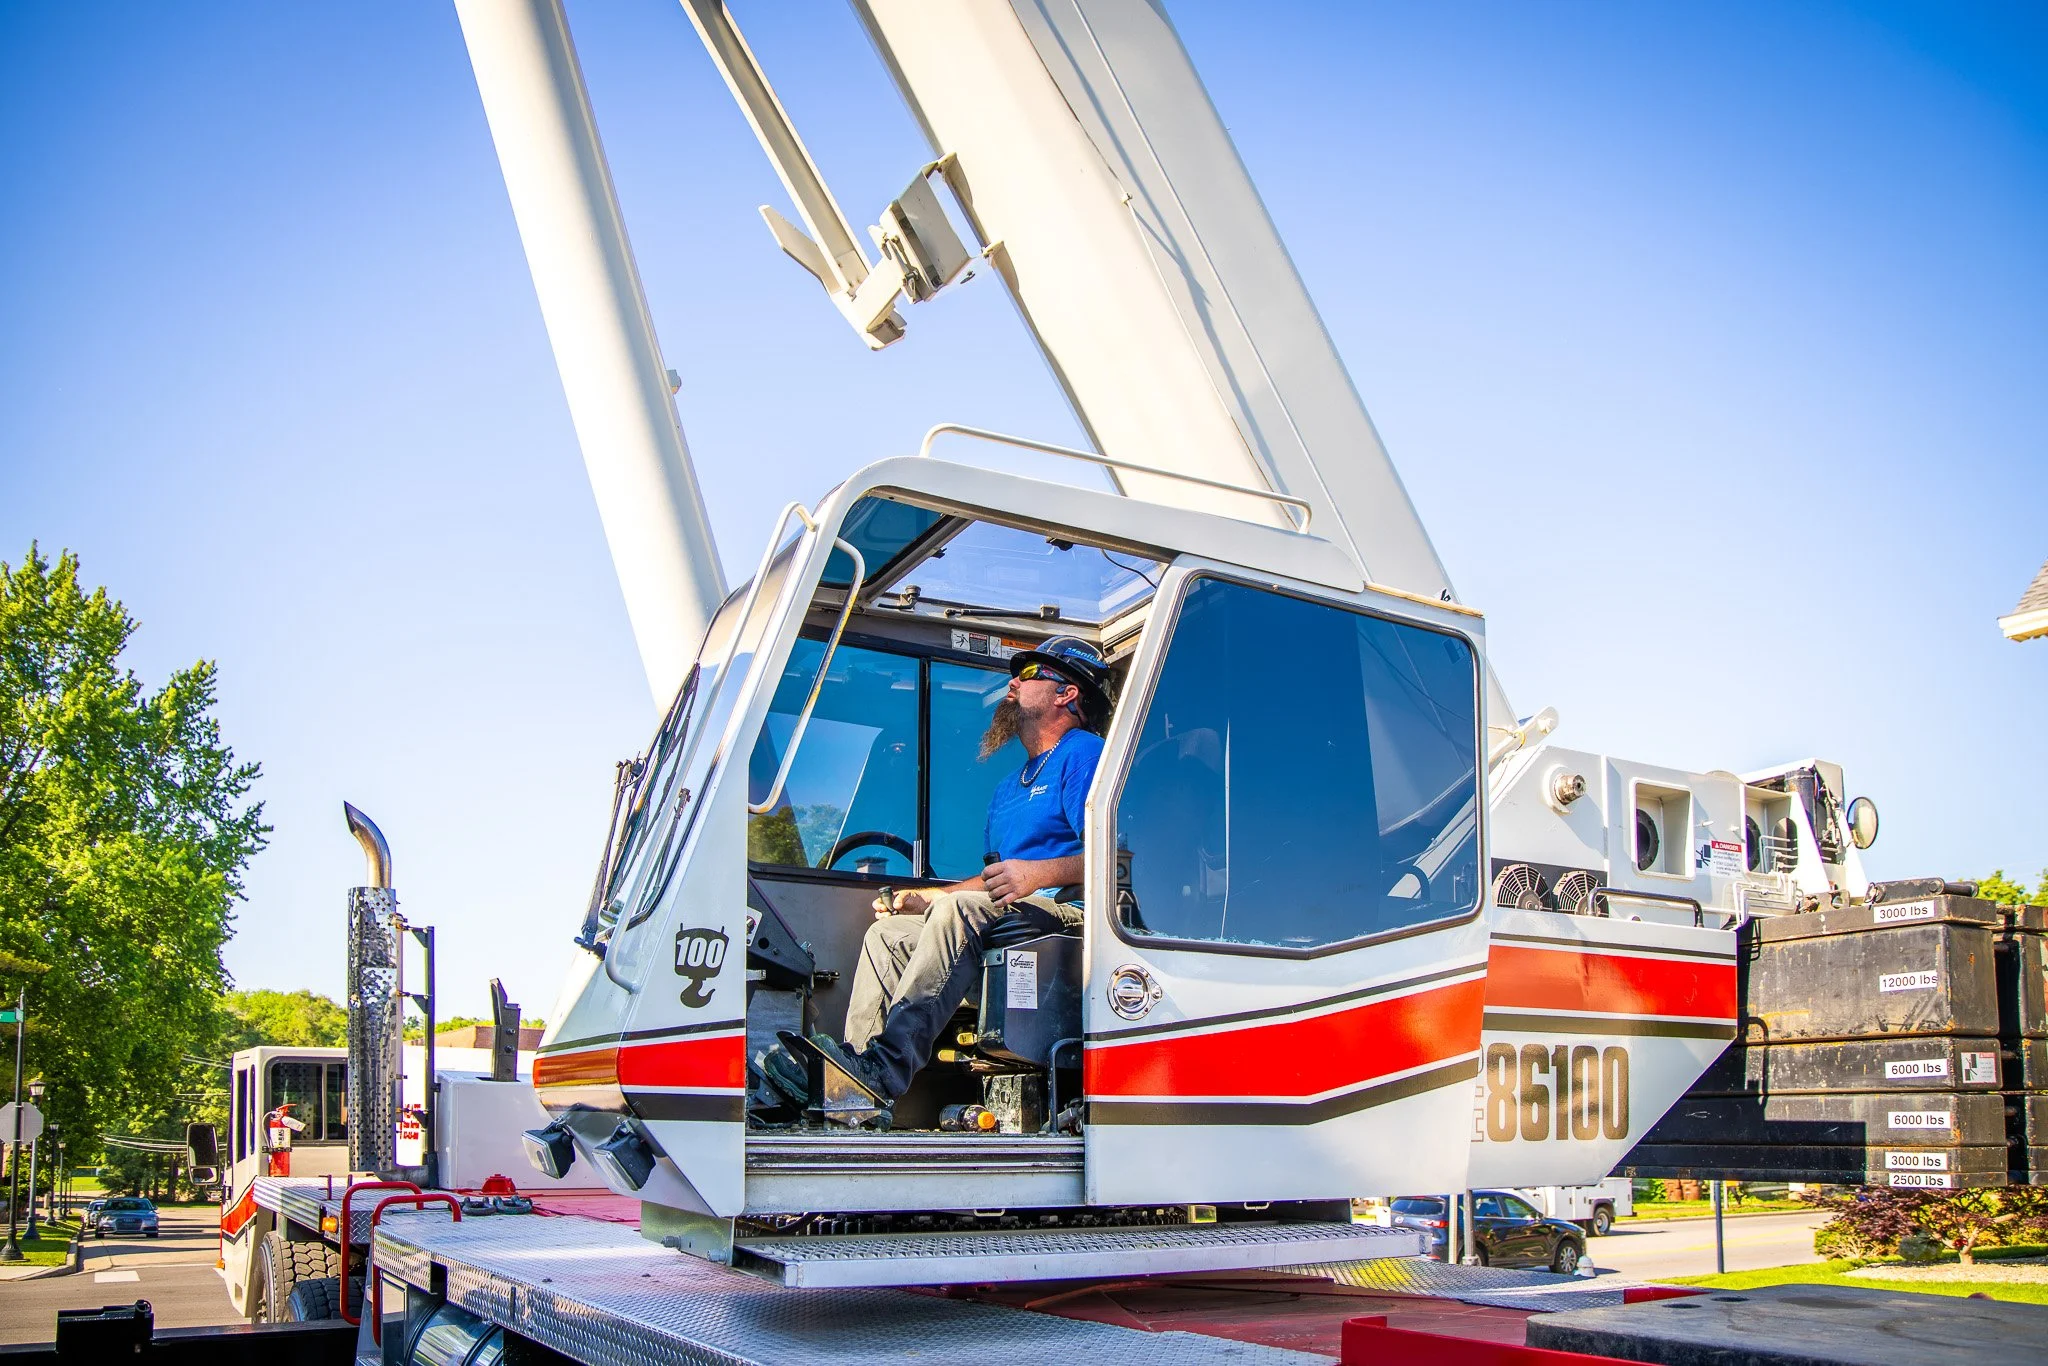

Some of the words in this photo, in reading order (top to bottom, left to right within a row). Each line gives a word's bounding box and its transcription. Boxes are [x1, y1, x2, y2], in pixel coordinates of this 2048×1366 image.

[1879, 907, 1907, 919] 3000
[1910, 906, 1928, 916] lbs
[676, 936, 726, 969] 100
[1882, 975, 1916, 988] 12000
[1919, 974, 1938, 985] lbs
[1891, 1064, 1920, 1075] 6000
[1923, 1063, 1942, 1073] lbs
[1486, 1042, 1629, 1143] 86100
[1894, 1115, 1922, 1125] 6000
[1926, 1115, 1945, 1125] lbs
[1891, 1155, 1919, 1166] 3000
[1923, 1156, 1941, 1167] lbs
[1893, 1175, 1922, 1185] 2500
[1925, 1175, 1944, 1186] lbs
